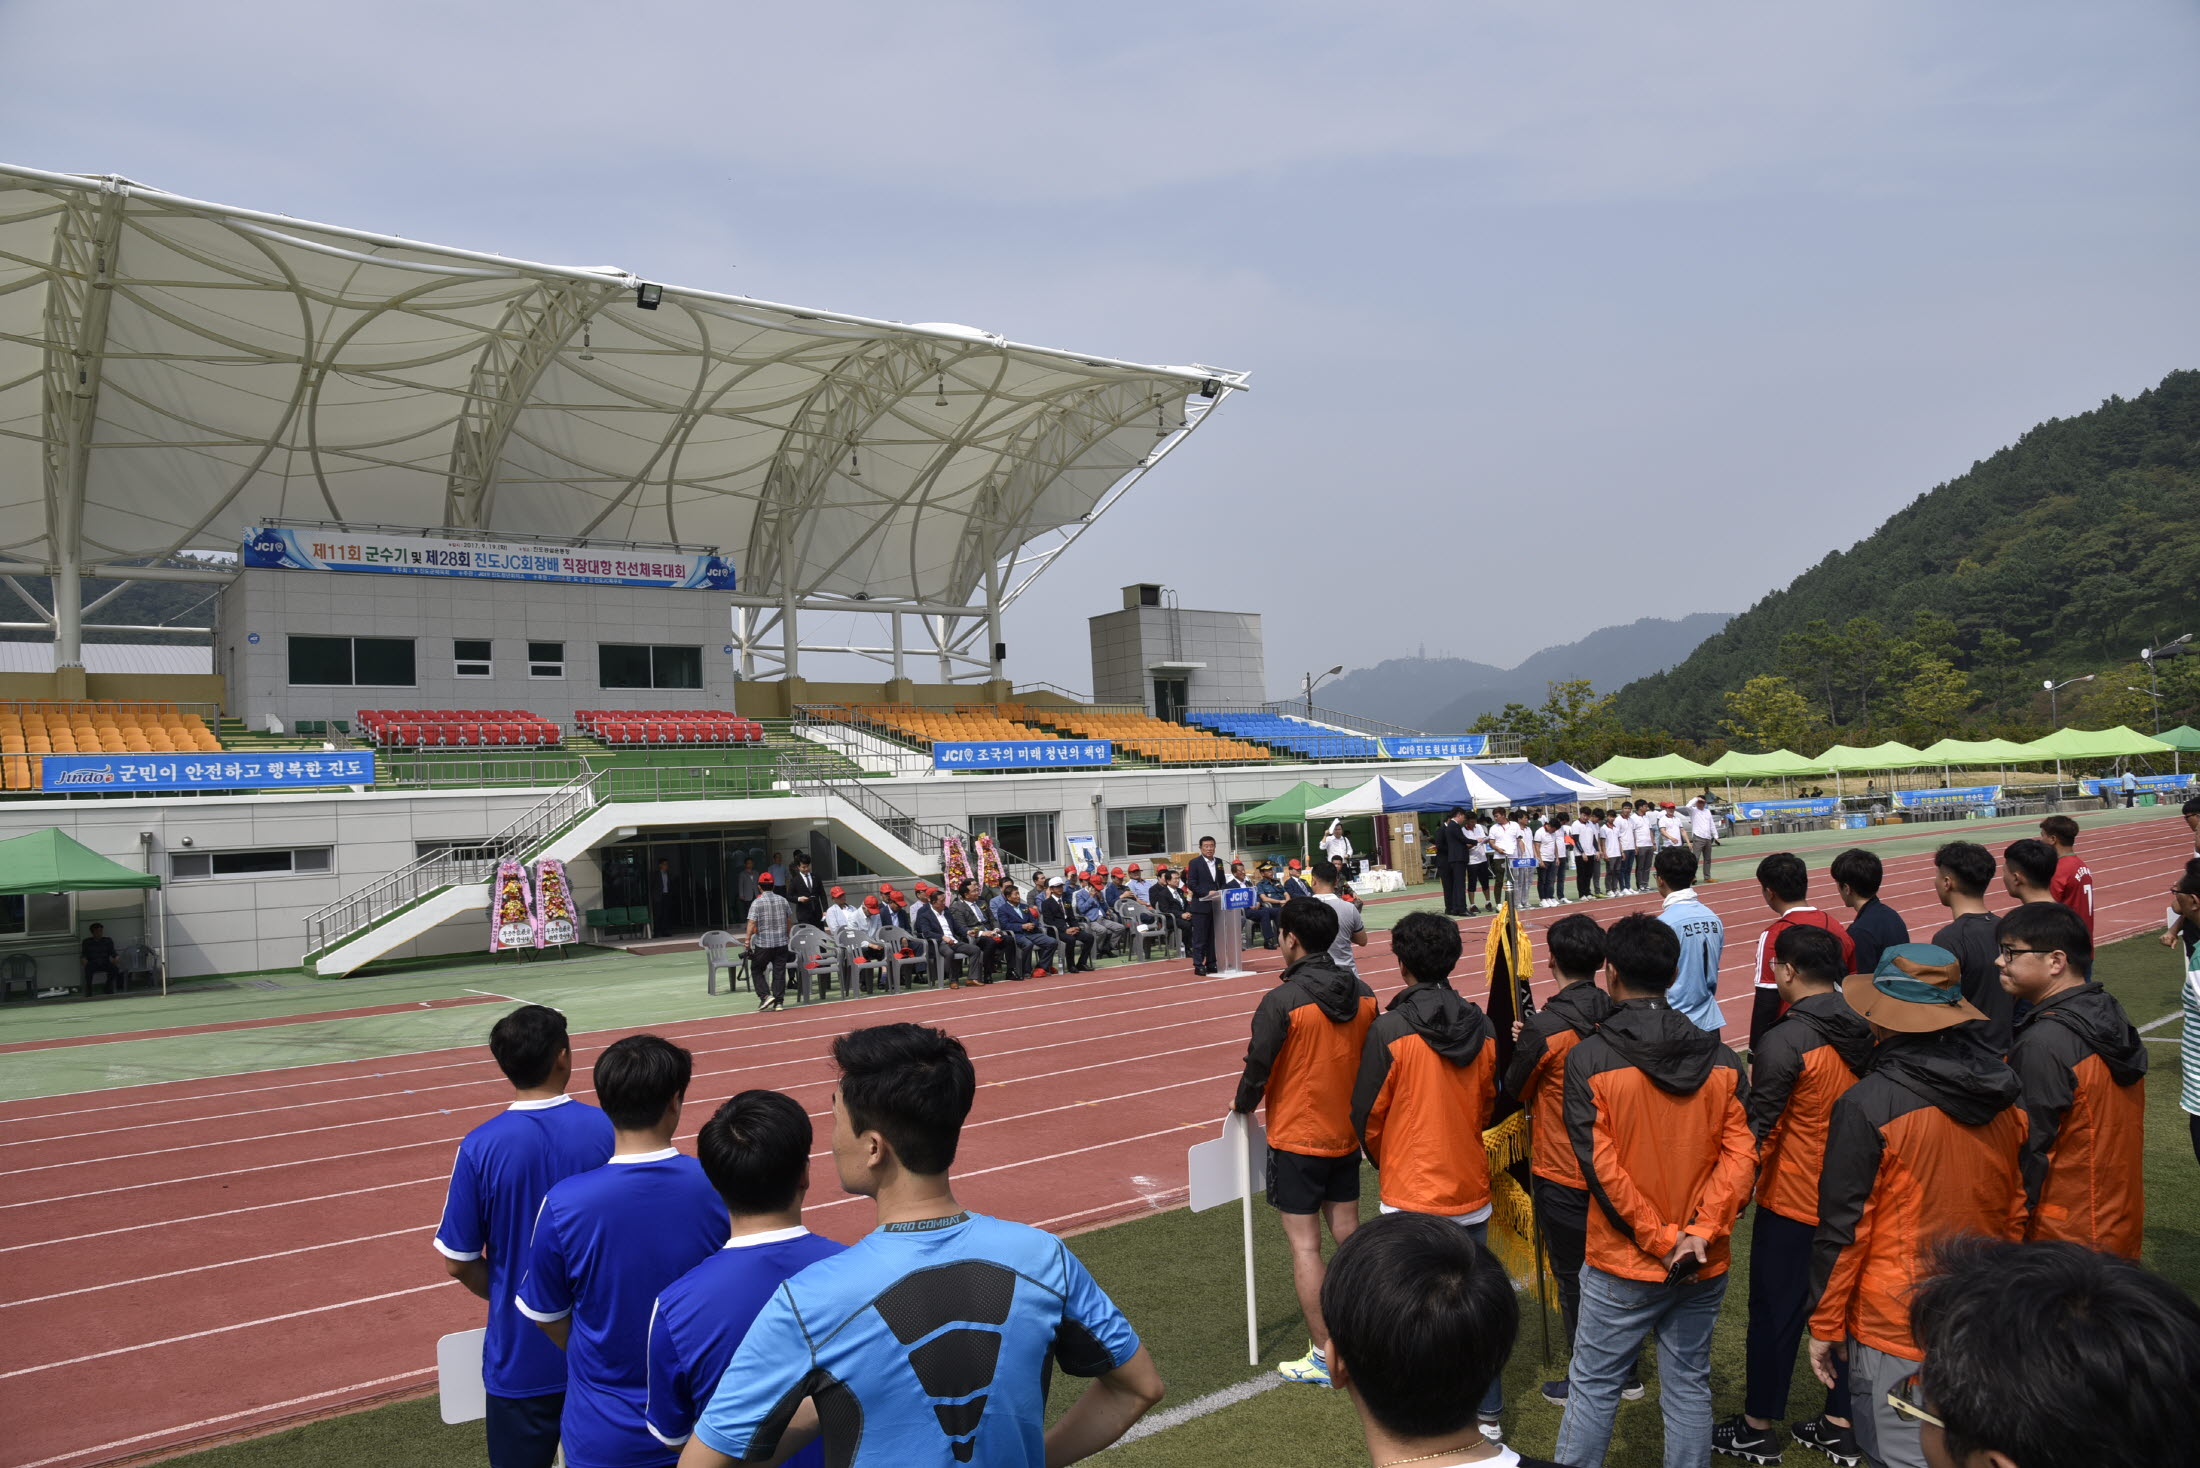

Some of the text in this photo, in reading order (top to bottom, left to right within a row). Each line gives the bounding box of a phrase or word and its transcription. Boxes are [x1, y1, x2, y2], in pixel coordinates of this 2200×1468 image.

[254, 543, 274, 552] JCI
[312, 542, 686, 579] 제11회 군수기 및 제28회 진도JC회장배 직장대항 친선체육대회
[707, 568, 722, 577] JCI
[942, 744, 1106, 762] JCI 조국의 미래 청년의 책임
[1397, 744, 1474, 756] JCI 진도청년회의소
[118, 763, 177, 783] 군민이
[184, 762, 262, 782] 안전하고
[266, 761, 322, 779] 행복한
[327, 760, 364, 777] 진도
[1230, 892, 1243, 902] JCI
[2083, 884, 2093, 917] 7
[890, 1215, 961, 1232] PRO COMBAT
